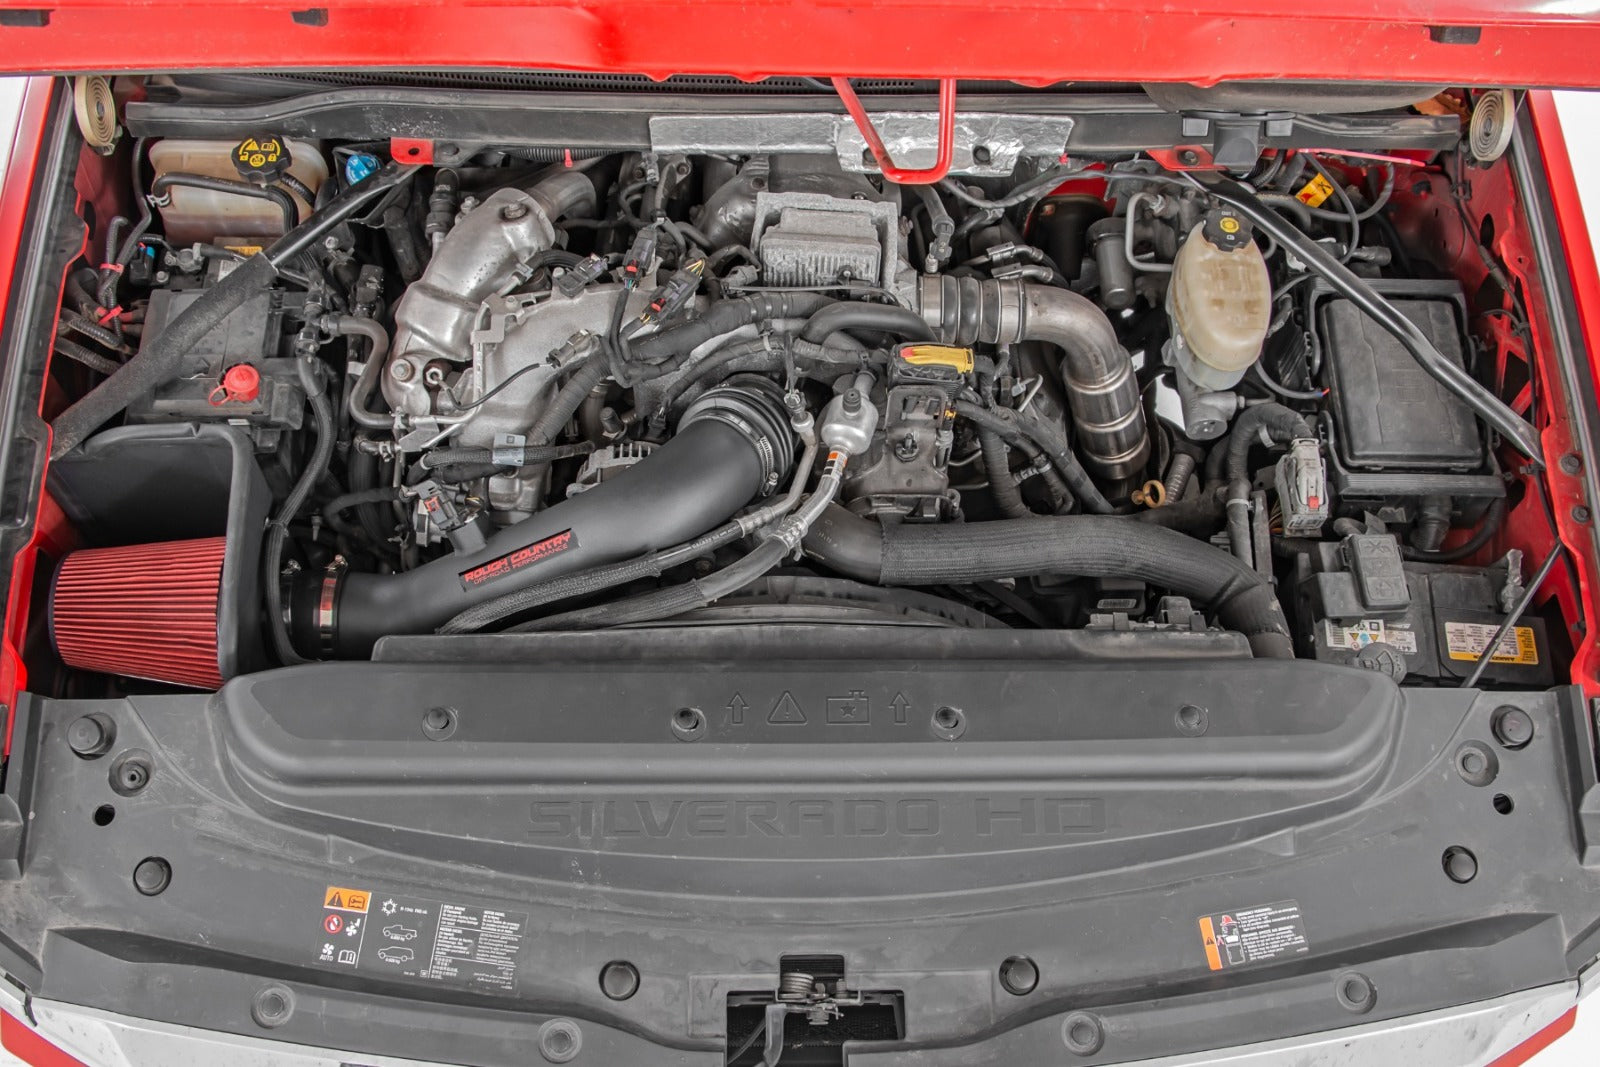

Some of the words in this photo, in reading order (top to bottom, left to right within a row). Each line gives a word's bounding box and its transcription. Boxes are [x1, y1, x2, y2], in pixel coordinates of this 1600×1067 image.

[464, 557, 508, 583] ROUGH
[510, 531, 571, 564] COUNTRY
[512, 543, 568, 569] PERFORMANCE
[527, 798, 940, 839] SILVERADO
[974, 798, 1106, 836] HD
